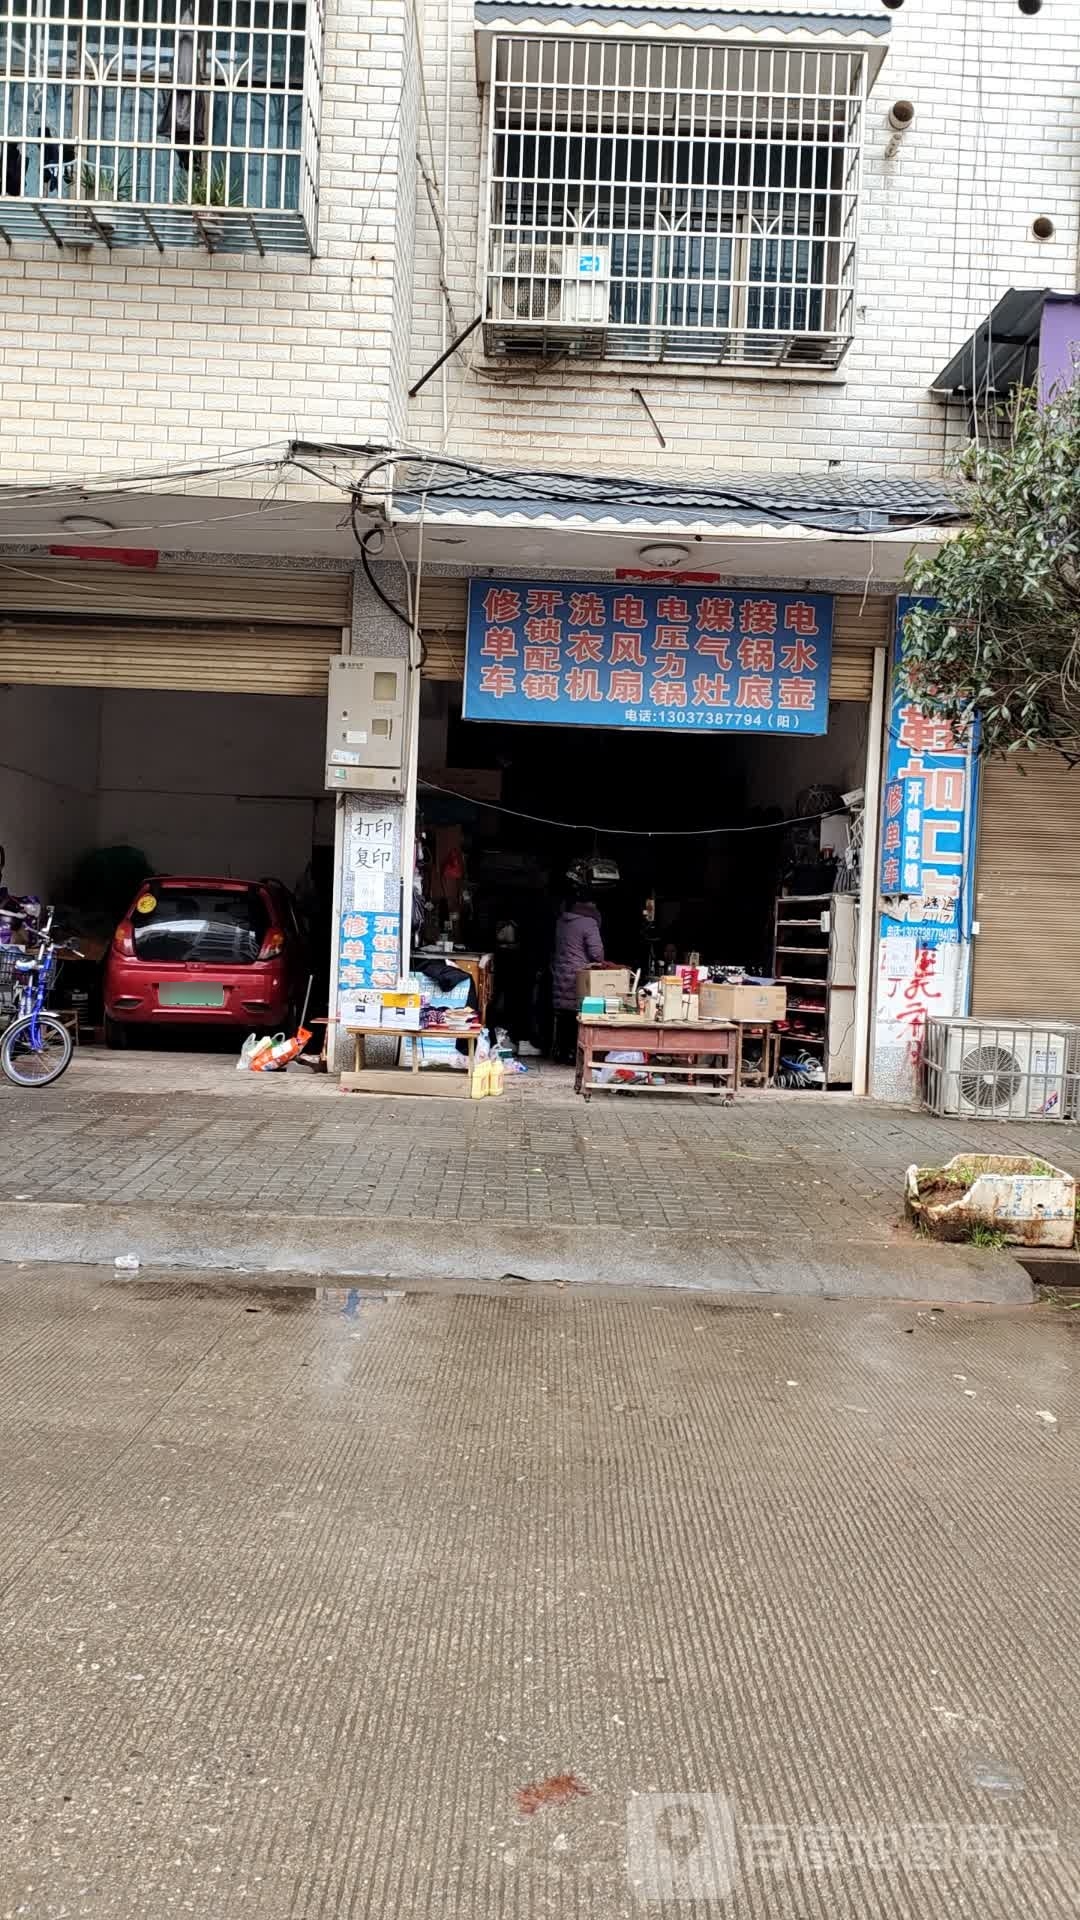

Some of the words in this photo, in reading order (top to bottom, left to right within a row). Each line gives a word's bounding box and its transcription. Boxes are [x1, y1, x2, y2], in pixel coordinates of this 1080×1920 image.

[479, 588, 520, 699] 修单车
[521, 589, 564, 701] 开锁配锁
[565, 592, 605, 702] 洗衣机
[606, 594, 648, 704] 电风扇
[650, 595, 692, 708] 电压力锅
[692, 597, 735, 707] 煤气灶
[735, 599, 777, 711] 接锅底
[777, 601, 820, 711] 电水壶
[354, 817, 392, 839] 打印
[354, 847, 391, 870] 复印
[884, 783, 903, 892] 修单车
[340, 914, 368, 989] 修单车
